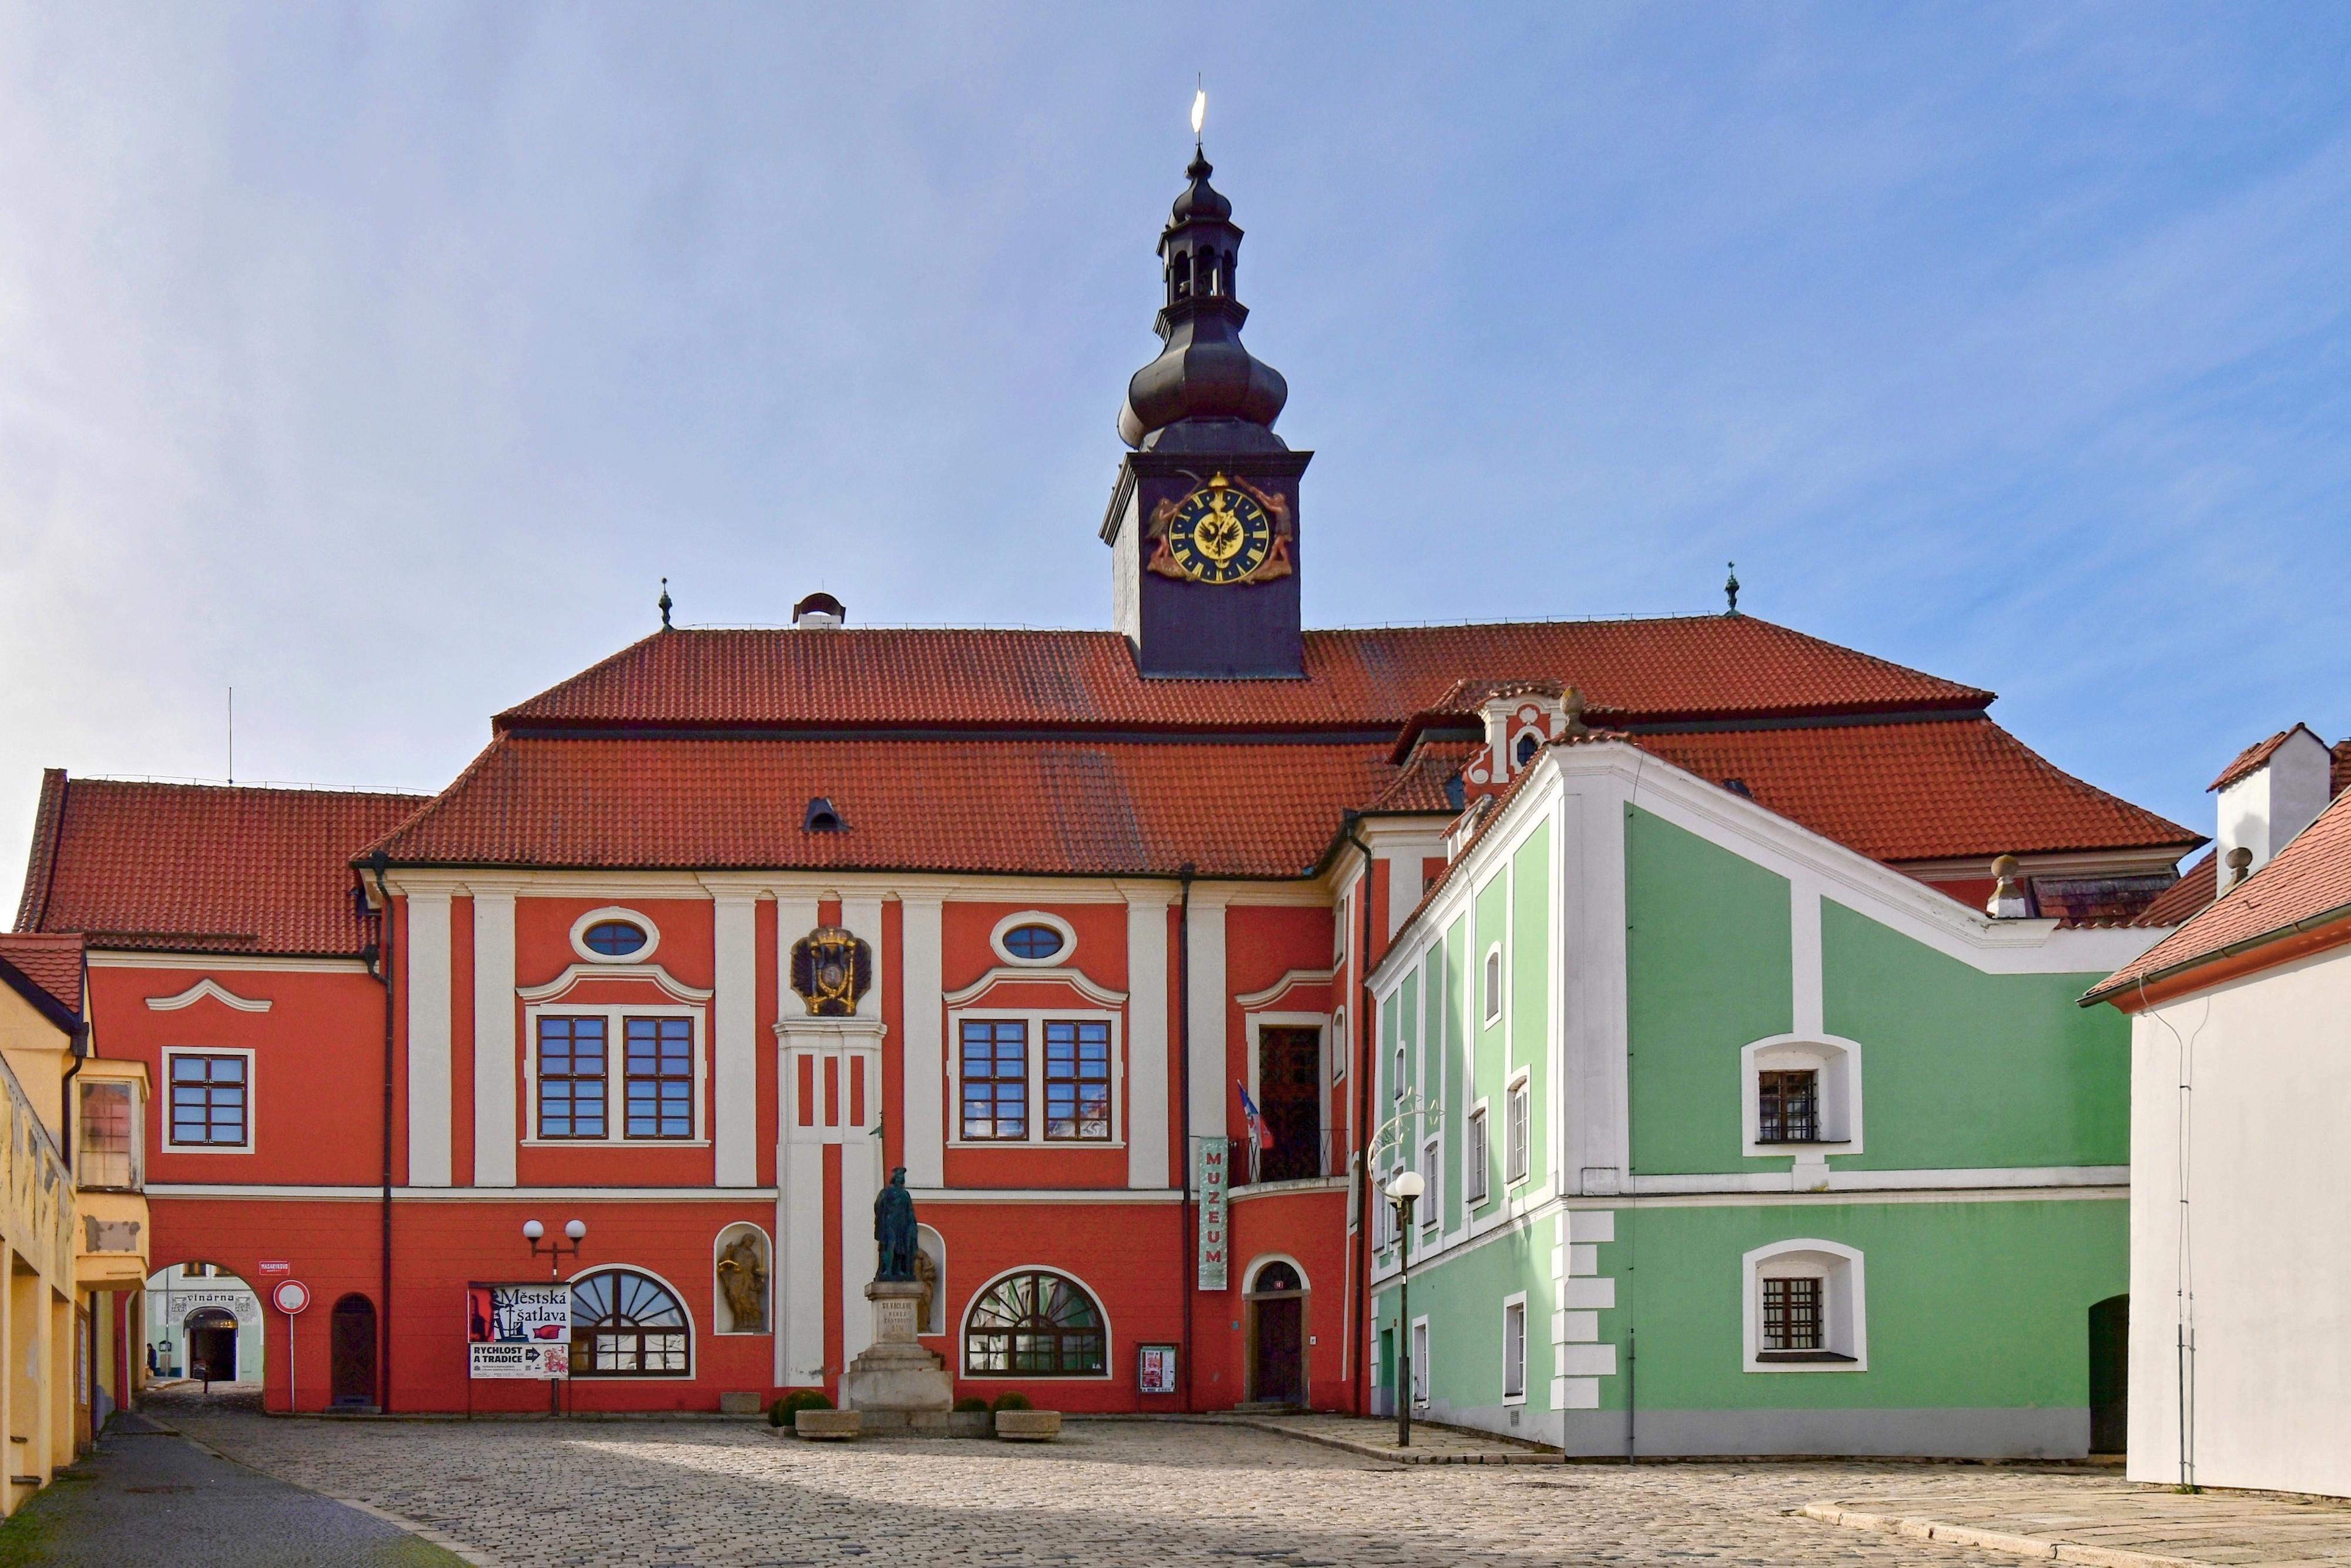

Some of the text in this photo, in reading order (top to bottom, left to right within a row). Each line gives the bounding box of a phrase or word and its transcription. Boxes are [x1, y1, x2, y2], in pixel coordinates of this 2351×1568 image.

[1234, 496, 1243, 508] I
[1247, 510, 1261, 521] II
[1236, 563, 1246, 577] V
[1205, 1152, 1221, 1263] MUZEUM
[500, 1289, 567, 1305] Městská
[517, 1306, 567, 1321] šatlava
